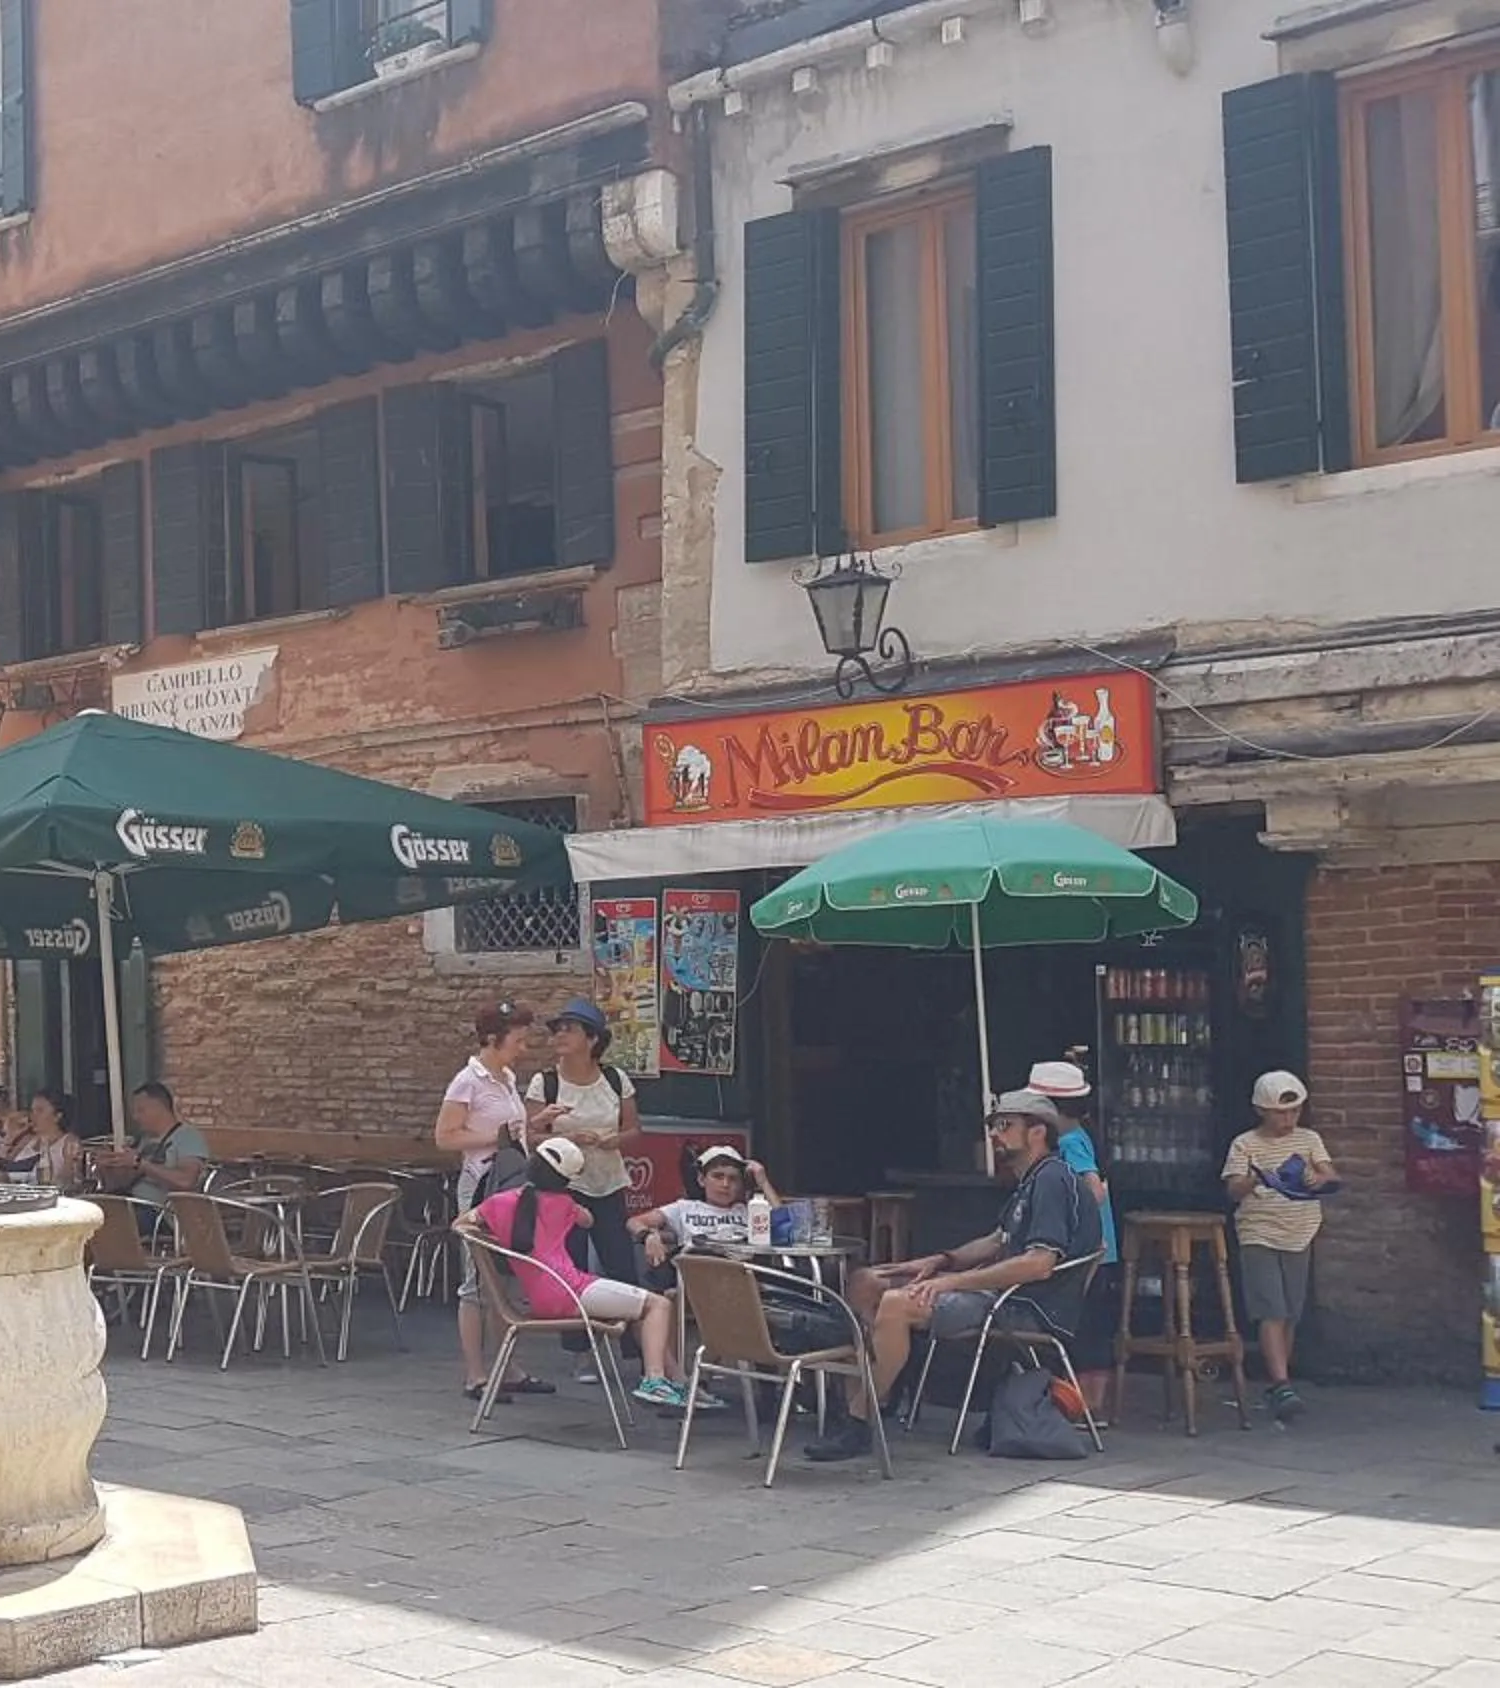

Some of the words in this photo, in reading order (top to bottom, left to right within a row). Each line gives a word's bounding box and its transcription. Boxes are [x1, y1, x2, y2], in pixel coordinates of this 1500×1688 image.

[147, 663, 243, 694] CAMPIELLO
[715, 717, 886, 808] Milan
[889, 703, 1029, 767] Bar
[115, 808, 209, 857] Gösser
[390, 823, 470, 868] Gösser
